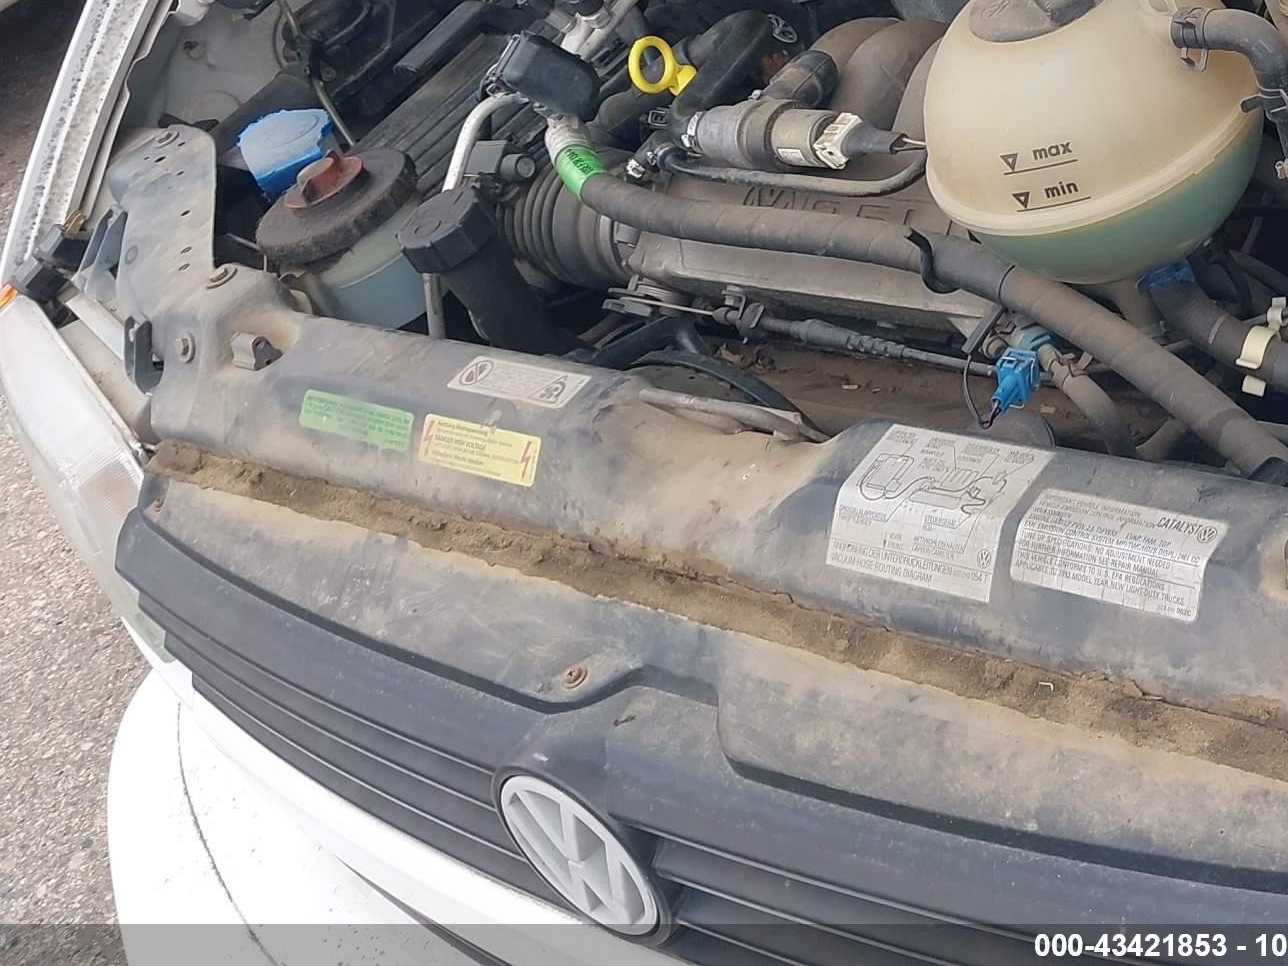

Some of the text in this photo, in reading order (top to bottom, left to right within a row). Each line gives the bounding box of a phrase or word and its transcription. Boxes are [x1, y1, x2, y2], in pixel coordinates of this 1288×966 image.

[1032, 142, 1072, 160] max
[1044, 181, 1079, 199] min
[1157, 516, 1202, 536] CATALYST
